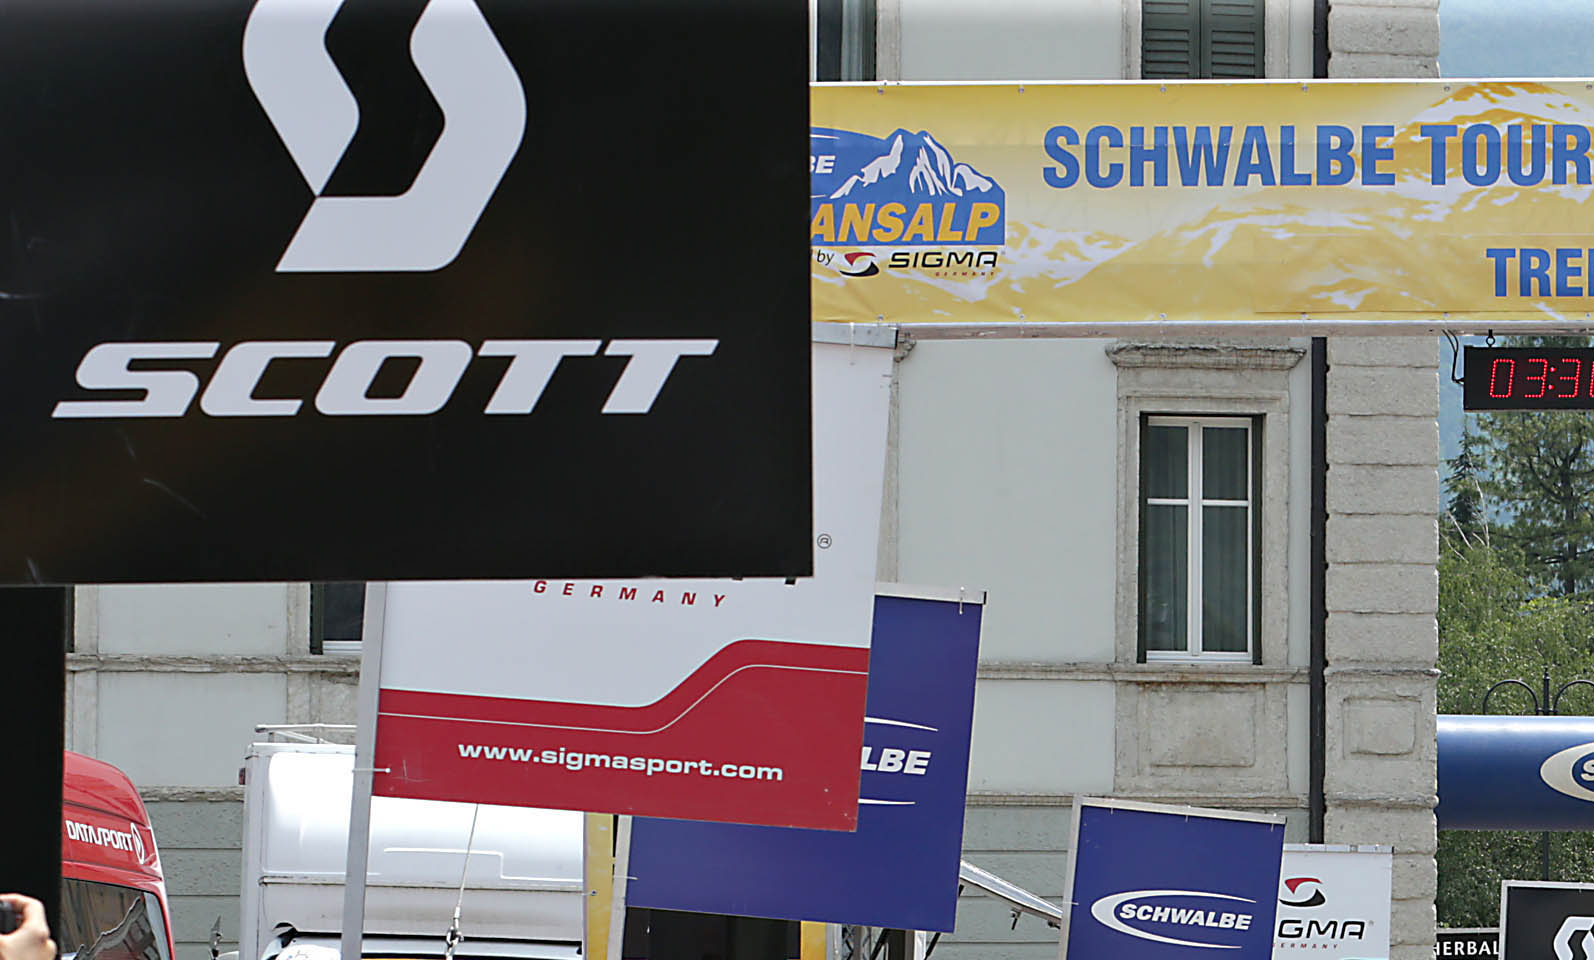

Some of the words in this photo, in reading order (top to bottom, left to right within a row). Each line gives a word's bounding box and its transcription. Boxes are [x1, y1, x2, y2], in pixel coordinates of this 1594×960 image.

[1043, 125, 1396, 189] SCHWALBE
[1420, 124, 1592, 186] TOUR
[811, 202, 1000, 242] ANSALP
[888, 251, 998, 268] SIGMA
[51, 340, 719, 417] SCOTT
[533, 580, 725, 607] GERMANY
[458, 740, 784, 781] www.sigmasport.com
[65, 820, 133, 852] DATASPORT
[1119, 903, 1252, 931] SCHWALBE
